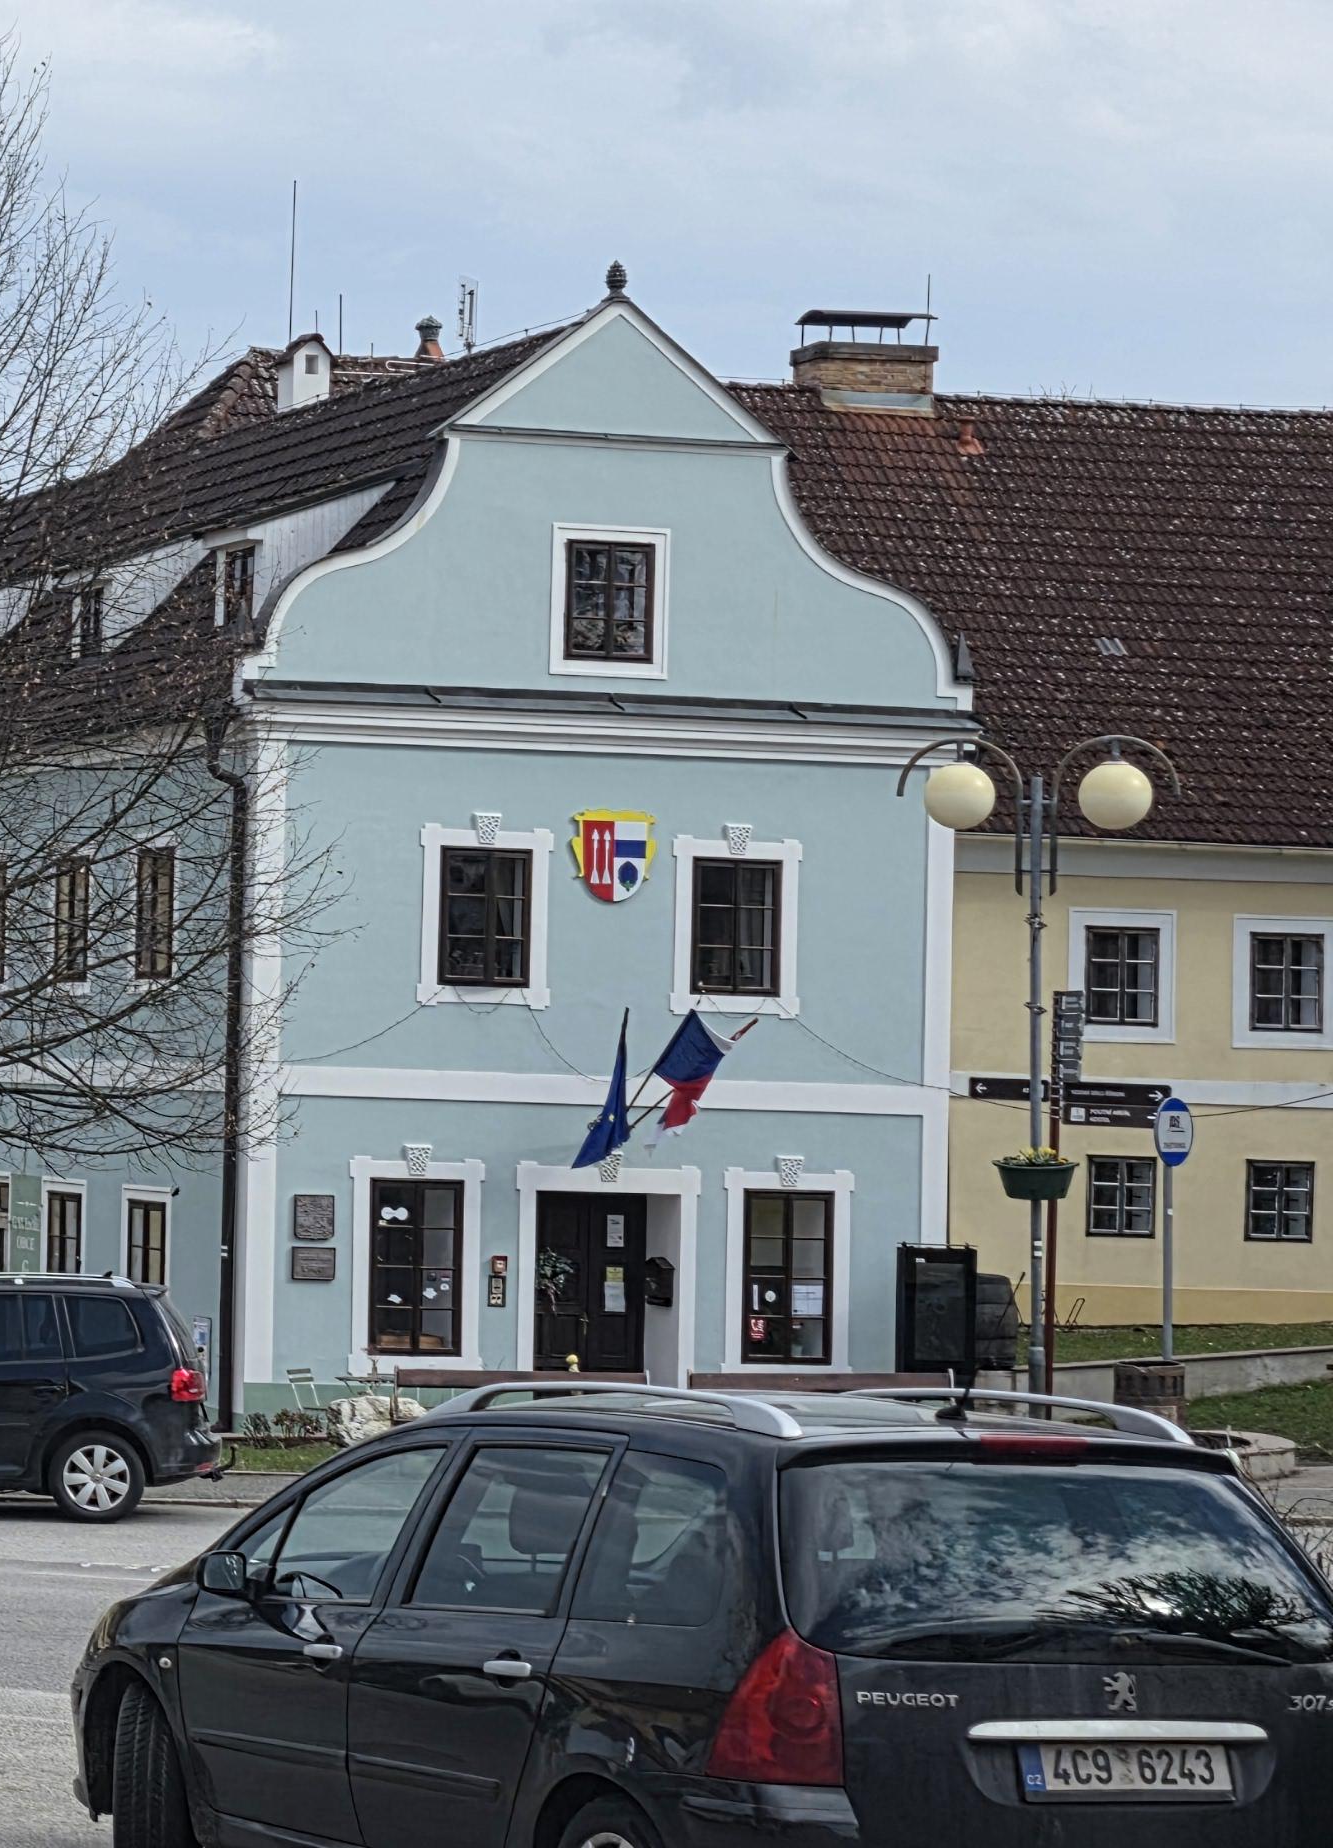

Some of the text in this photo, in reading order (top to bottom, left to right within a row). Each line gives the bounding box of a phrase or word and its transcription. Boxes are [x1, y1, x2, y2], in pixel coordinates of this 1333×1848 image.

[856, 1691, 960, 1707] PEUGEOT
[1052, 1748, 1215, 1785] 4C9 6243
[1026, 1774, 1044, 1786] CZ
